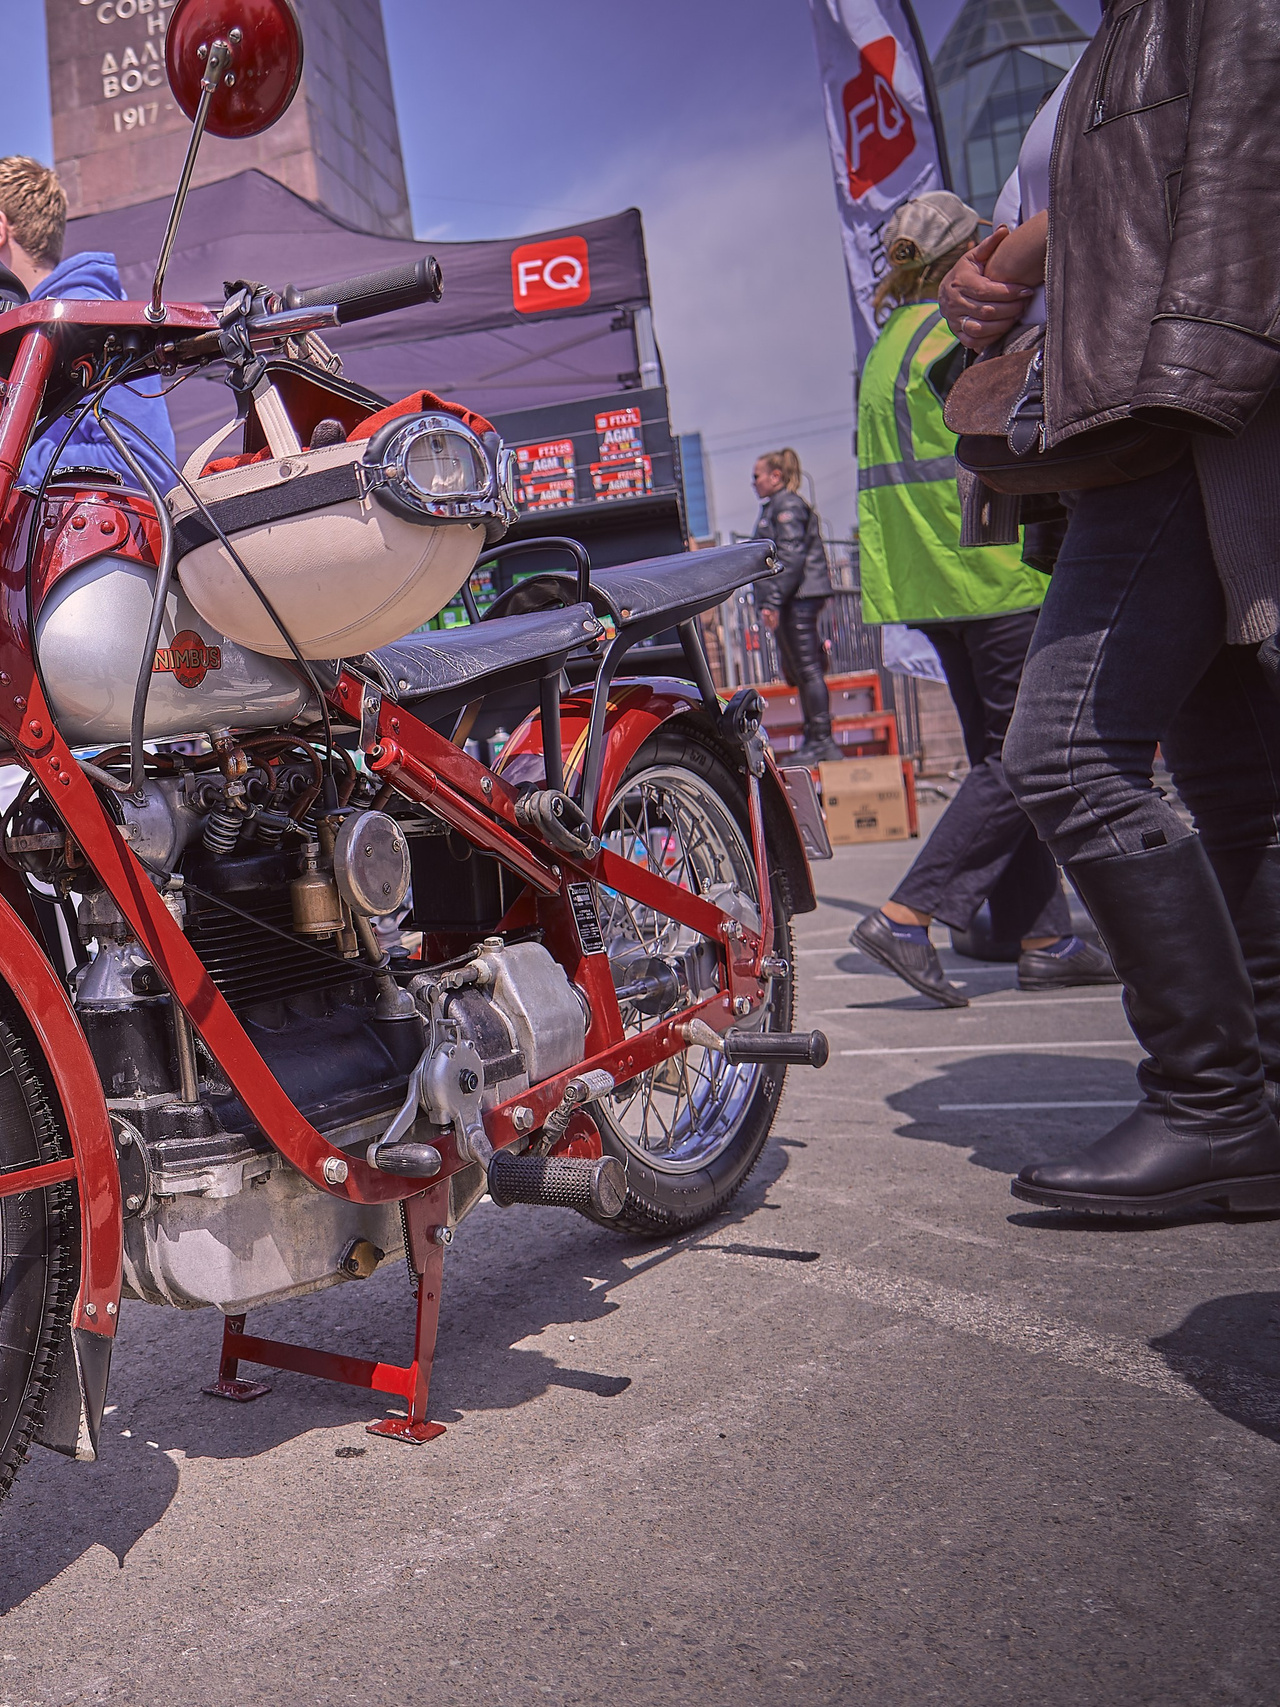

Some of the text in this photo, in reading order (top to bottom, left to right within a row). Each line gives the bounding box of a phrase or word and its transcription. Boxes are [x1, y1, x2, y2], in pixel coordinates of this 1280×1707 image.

[101, 37, 166, 75] ДАЛ
[102, 63, 166, 98] ВОС
[113, 102, 158, 133] 1917
[848, 74, 905, 172] FQ
[517, 255, 583, 296] FQ
[604, 427, 635, 444] AGM
[532, 457, 559, 471] AGM
[154, 648, 219, 669] NIMBUS
